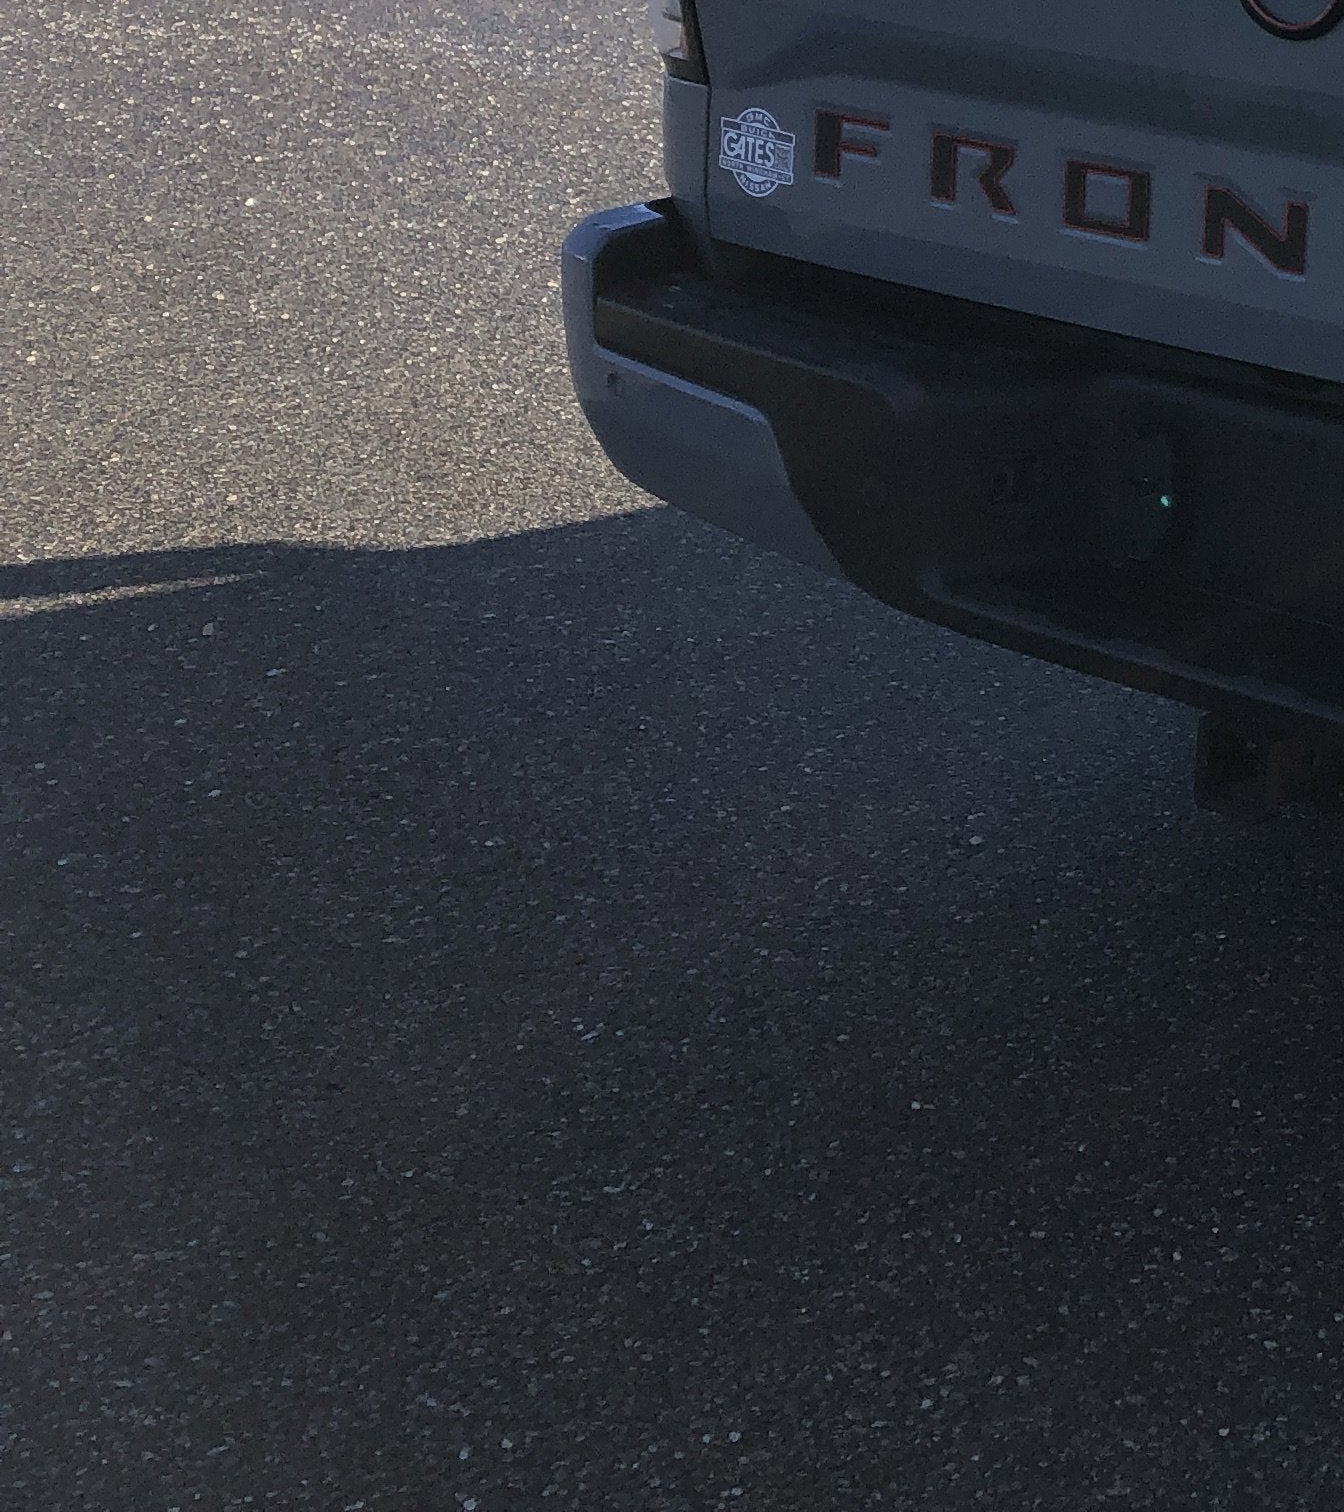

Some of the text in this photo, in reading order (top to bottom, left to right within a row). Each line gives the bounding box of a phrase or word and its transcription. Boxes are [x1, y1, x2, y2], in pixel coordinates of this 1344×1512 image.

[746, 112, 771, 127] GMC
[740, 124, 776, 140] BUICK
[723, 131, 775, 168] GATES
[739, 173, 772, 192] NISSAN
